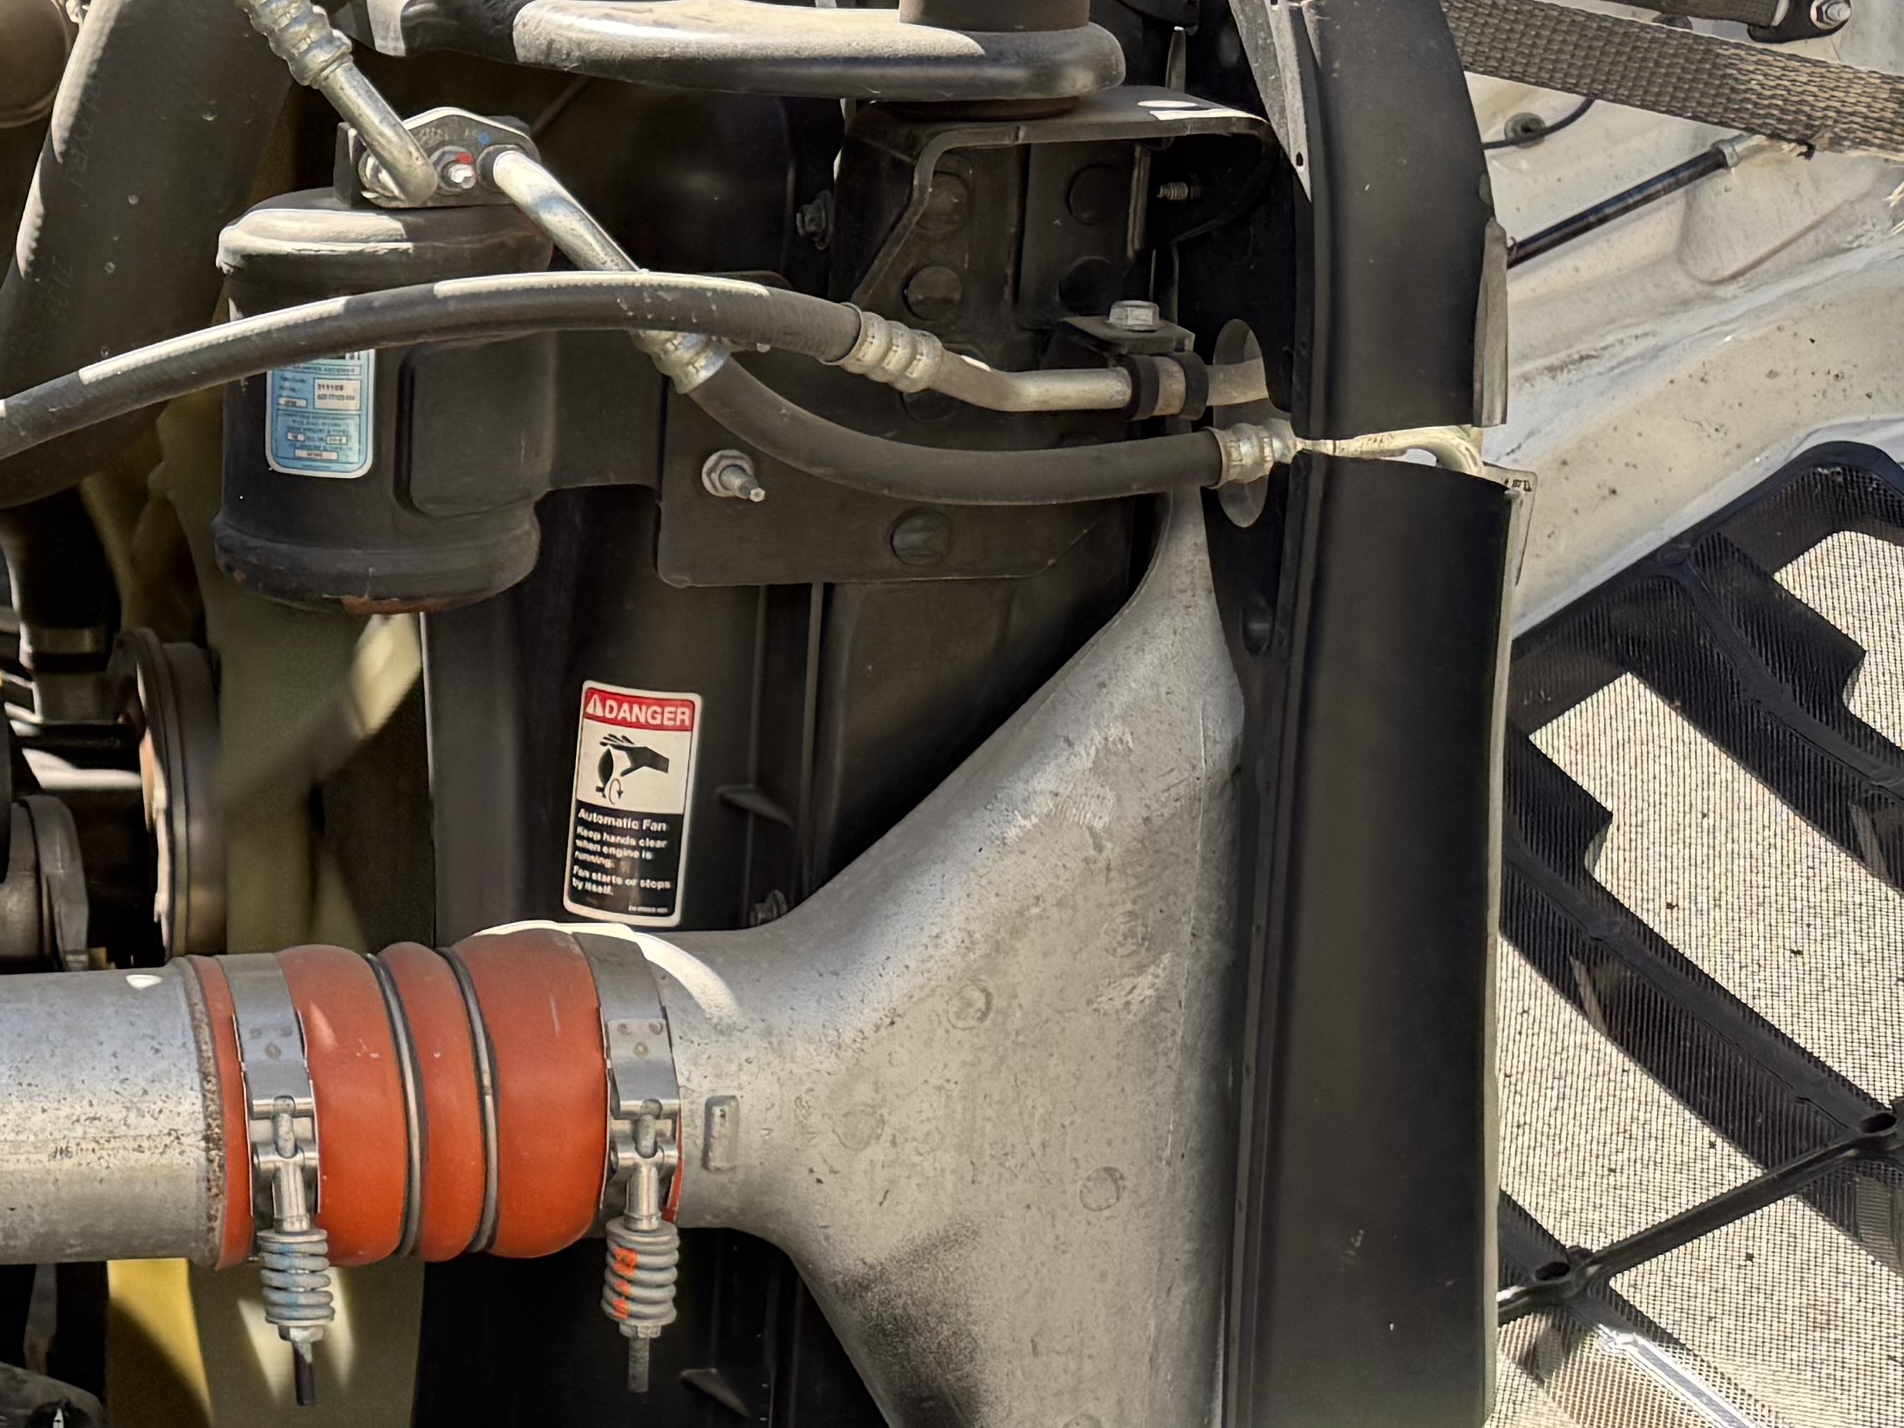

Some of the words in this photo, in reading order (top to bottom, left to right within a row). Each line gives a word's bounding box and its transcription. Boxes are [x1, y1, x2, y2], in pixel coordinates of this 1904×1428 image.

[604, 699, 691, 727] DANGER
[577, 808, 640, 831] Automatic
[642, 819, 667, 832] Fan
[576, 827, 601, 842] Keep
[602, 832, 636, 846] hands
[639, 837, 668, 849] clear
[574, 852, 615, 869] running.
[575, 839, 601, 853] when
[602, 844, 640, 860] engine
[642, 848, 652, 860] is
[572, 878, 584, 892] by
[573, 865, 591, 878] Fan
[592, 871, 623, 885] starts
[625, 877, 638, 886] or
[640, 878, 671, 890] stops
